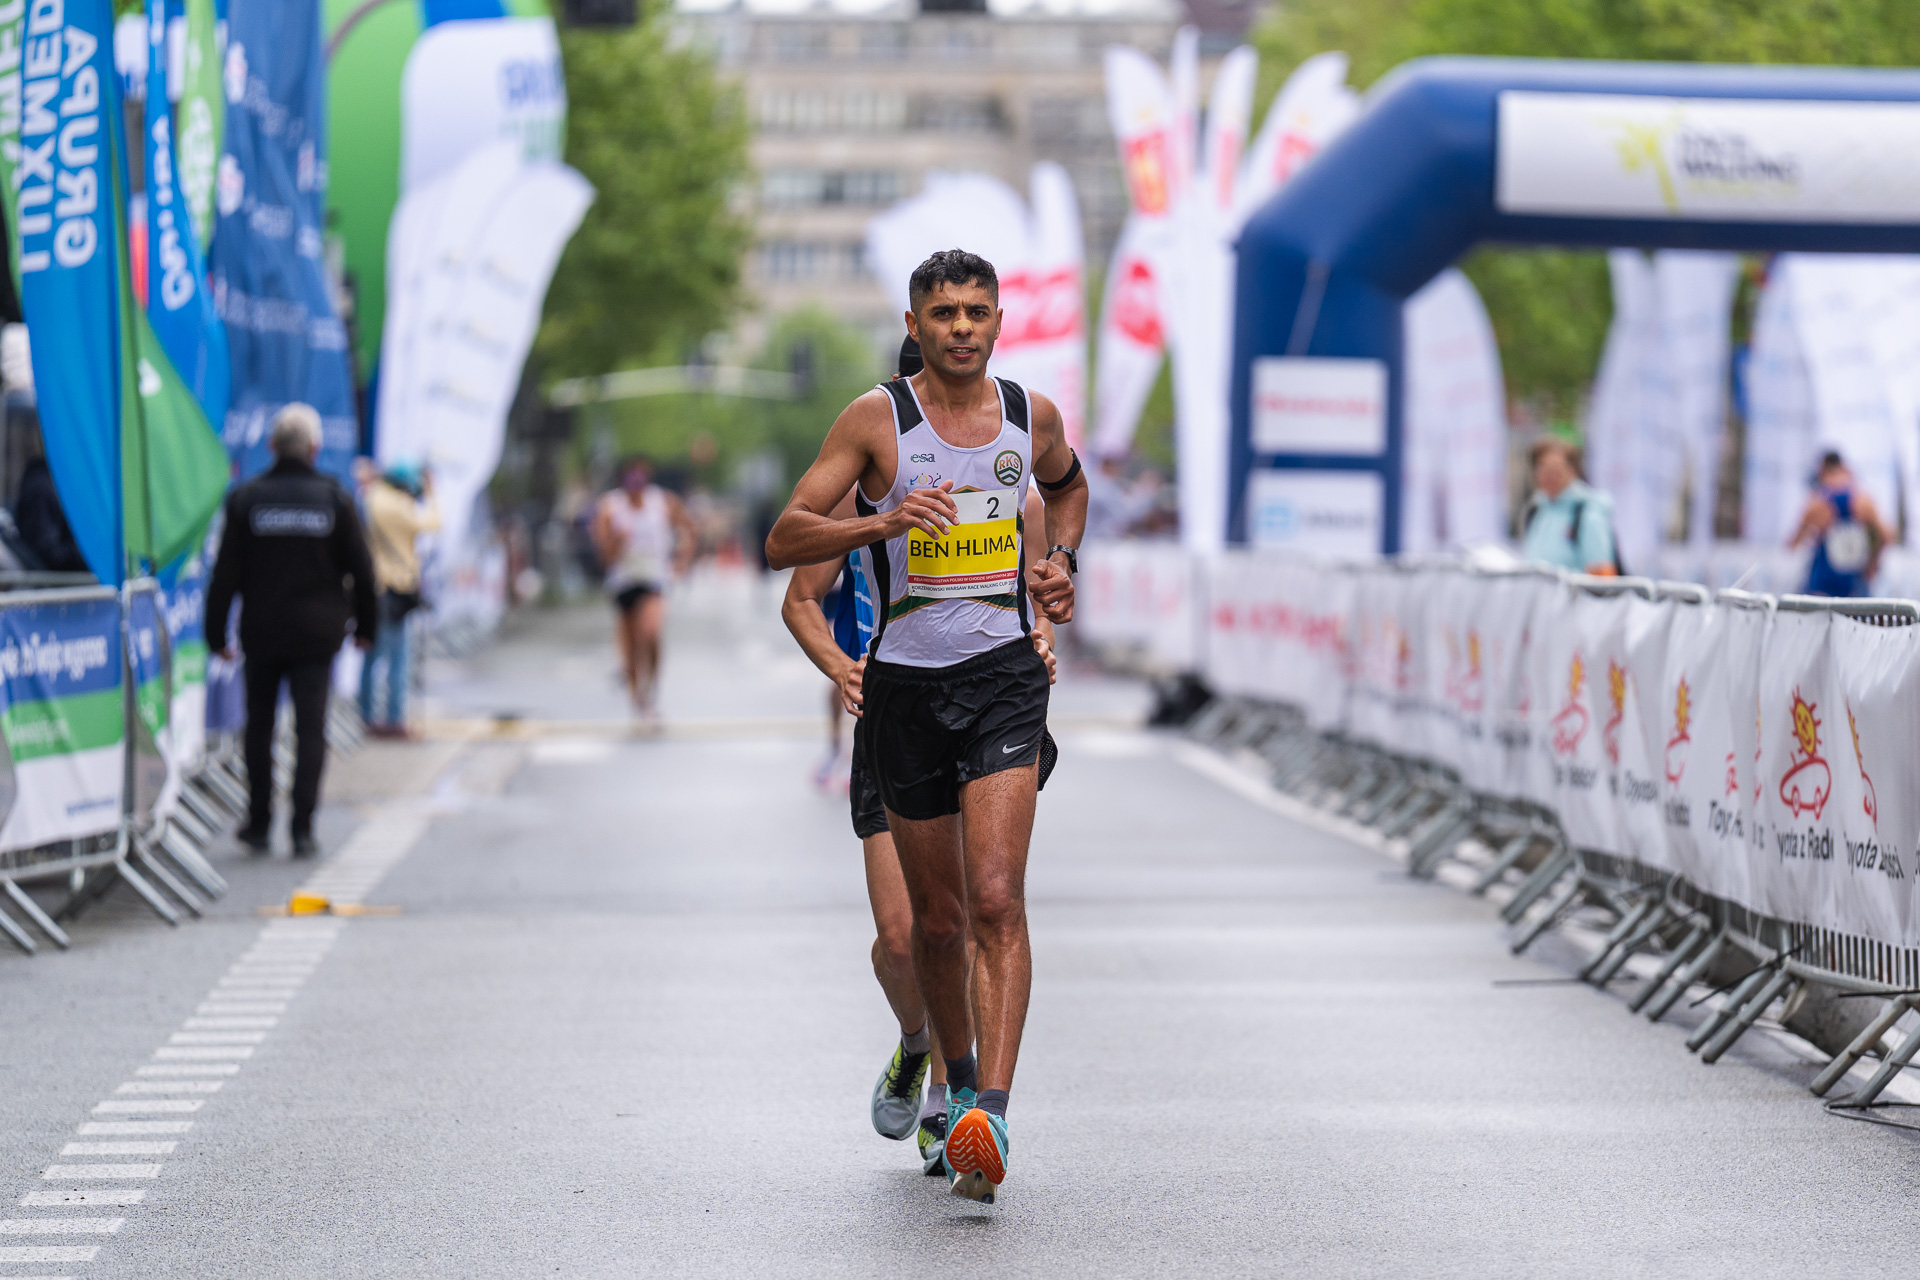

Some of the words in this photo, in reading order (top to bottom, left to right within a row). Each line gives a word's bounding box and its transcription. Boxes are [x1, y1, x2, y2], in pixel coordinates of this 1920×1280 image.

[911, 453, 936, 463] esa
[998, 455, 1020, 469] RKS
[986, 496, 1000, 520] 2
[910, 539, 949, 559] BEN
[957, 534, 1016, 557] HLIMA
